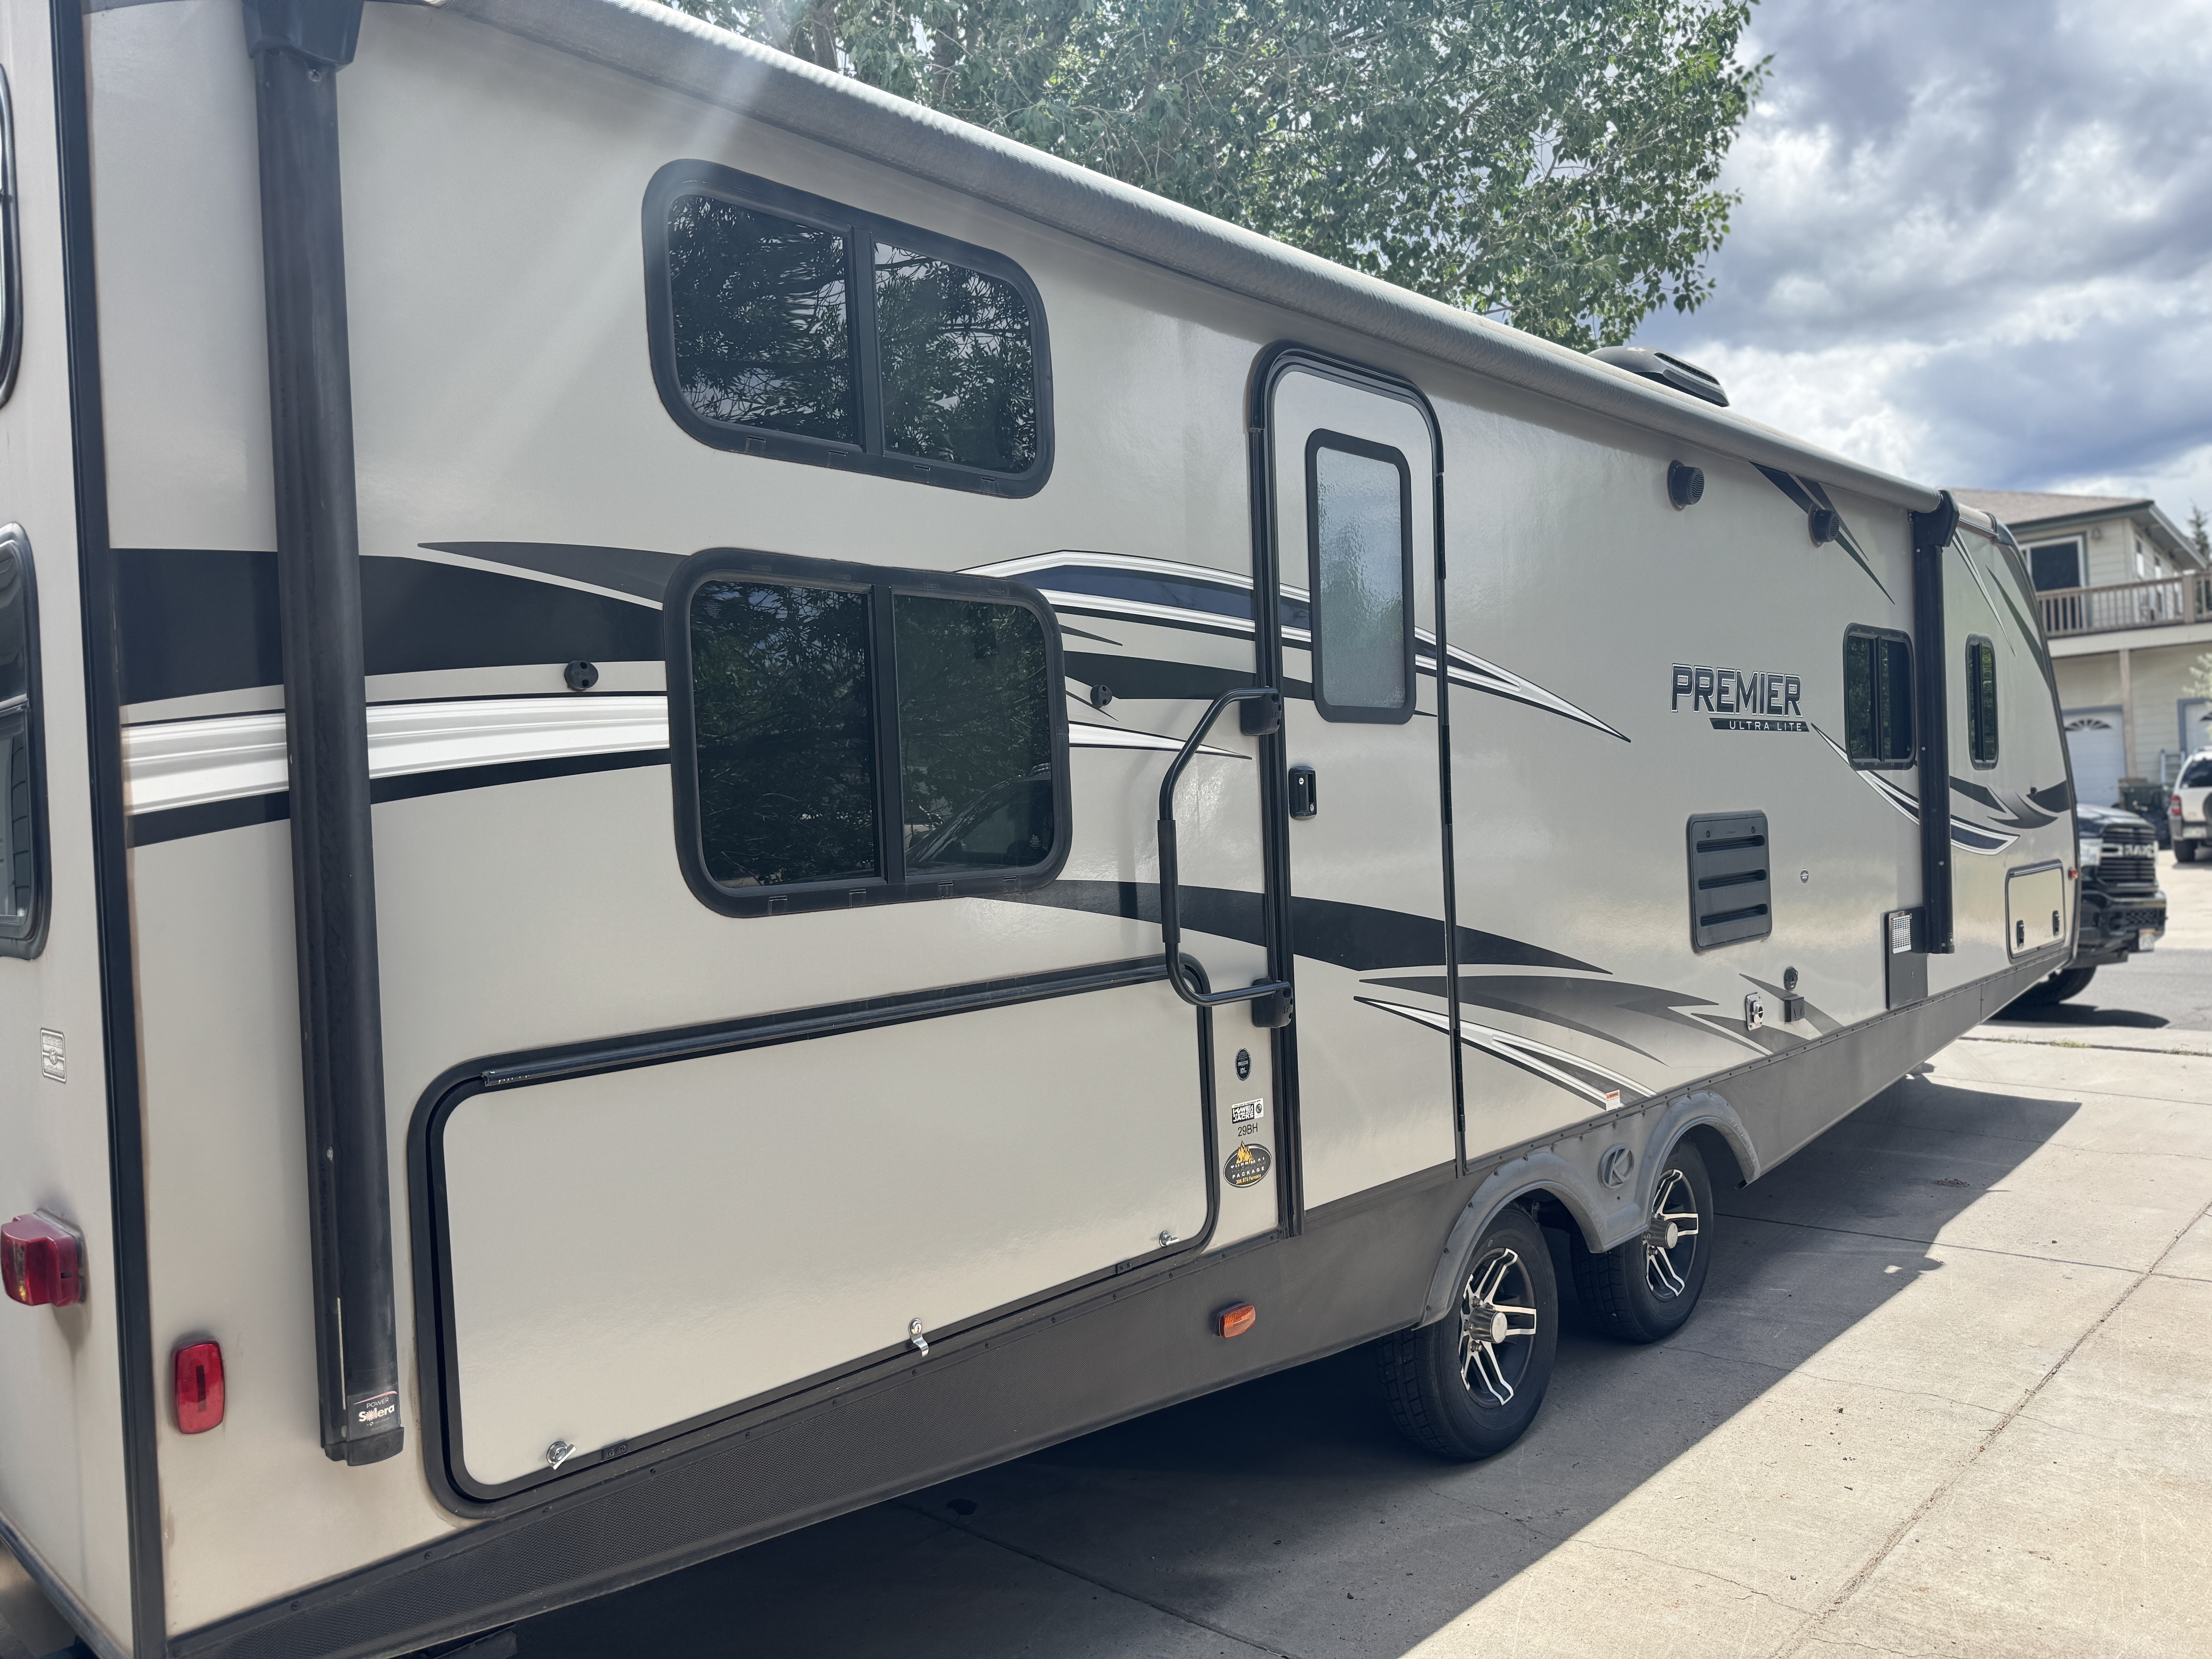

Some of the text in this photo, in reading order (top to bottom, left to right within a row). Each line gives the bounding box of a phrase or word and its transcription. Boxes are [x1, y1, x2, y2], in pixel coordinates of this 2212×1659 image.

[1671, 663, 1803, 718] PREMIER
[1729, 720, 1802, 731] ULTRA LITE
[1233, 1105, 1254, 1115] POWER
[1233, 1113, 1254, 1122] JACKS
[1238, 1122, 1258, 1137] 29BH
[1232, 1166, 1265, 1179] PACKAGE
[366, 1397, 389, 1408] POWER
[359, 1404, 395, 1422] Solera
